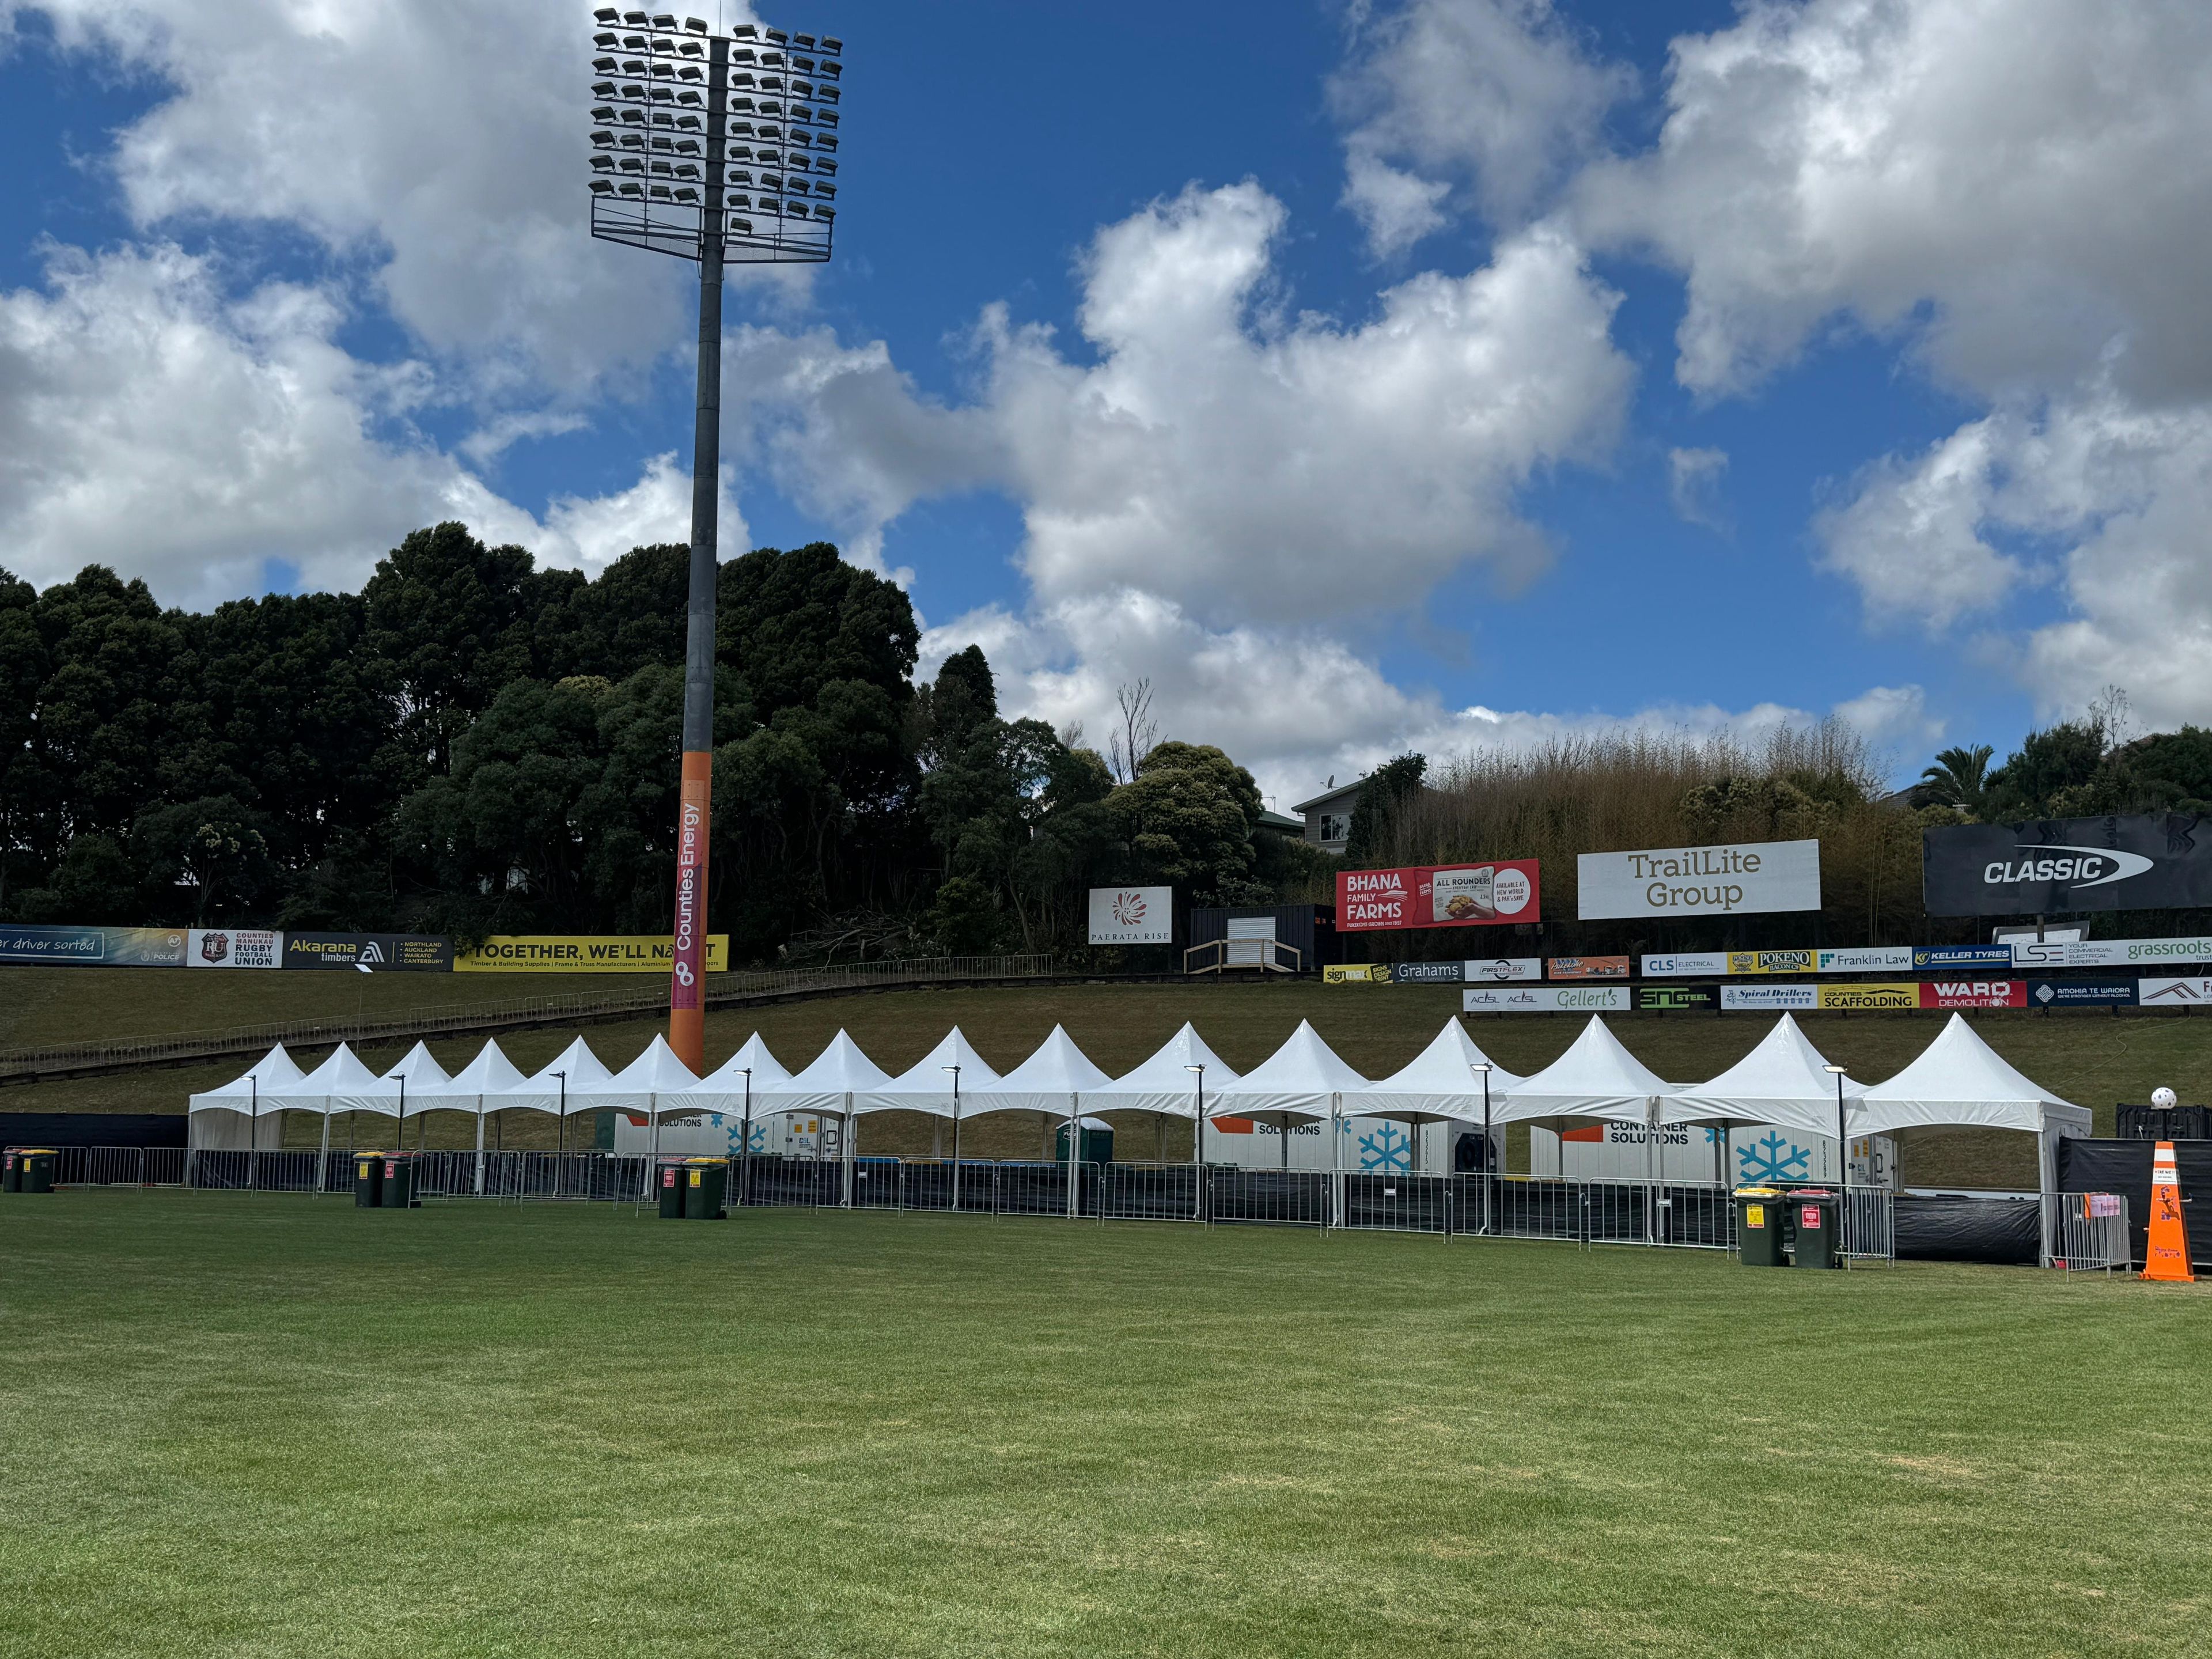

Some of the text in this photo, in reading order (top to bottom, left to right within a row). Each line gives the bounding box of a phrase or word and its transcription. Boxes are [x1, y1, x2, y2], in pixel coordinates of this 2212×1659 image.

[1628, 849, 1762, 878] TrailLite
[1984, 857, 2103, 884] CLASSIC
[677, 802, 699, 951] Counties Energy
[1347, 873, 1402, 892] BHANA
[1347, 893, 1376, 903] FAMILY
[1646, 882, 1743, 911] Group
[1347, 903, 1402, 920] FARMS
[13, 938, 51, 950] driver
[54, 939, 96, 952] sorted
[289, 940, 357, 953] Akarana
[2128, 940, 2211, 960] grassroots
[321, 952, 356, 962] timbers
[472, 944, 584, 961] TOGETHER,
[588, 944, 646, 959] WE'LL
[1759, 952, 1810, 967] POKENO
[1838, 954, 1881, 965] Franklin
[1886, 954, 1909, 964] Law
[1931, 952, 1972, 960] KELLER
[1373, 964, 1387, 973] SIGNS
[1399, 963, 1459, 977] Grahams
[1649, 960, 1674, 971] CLS
[1327, 968, 1368, 982] signmax
[1373, 969, 1392, 978] DESIGN
[1738, 990, 1770, 998] Spiral
[1933, 981, 2010, 997] WARD
[1557, 988, 1618, 1009] Gellert's
[1825, 997, 1912, 1007] SCAFFOLDING
[1259, 1124, 1320, 1135] SOLTIONS
